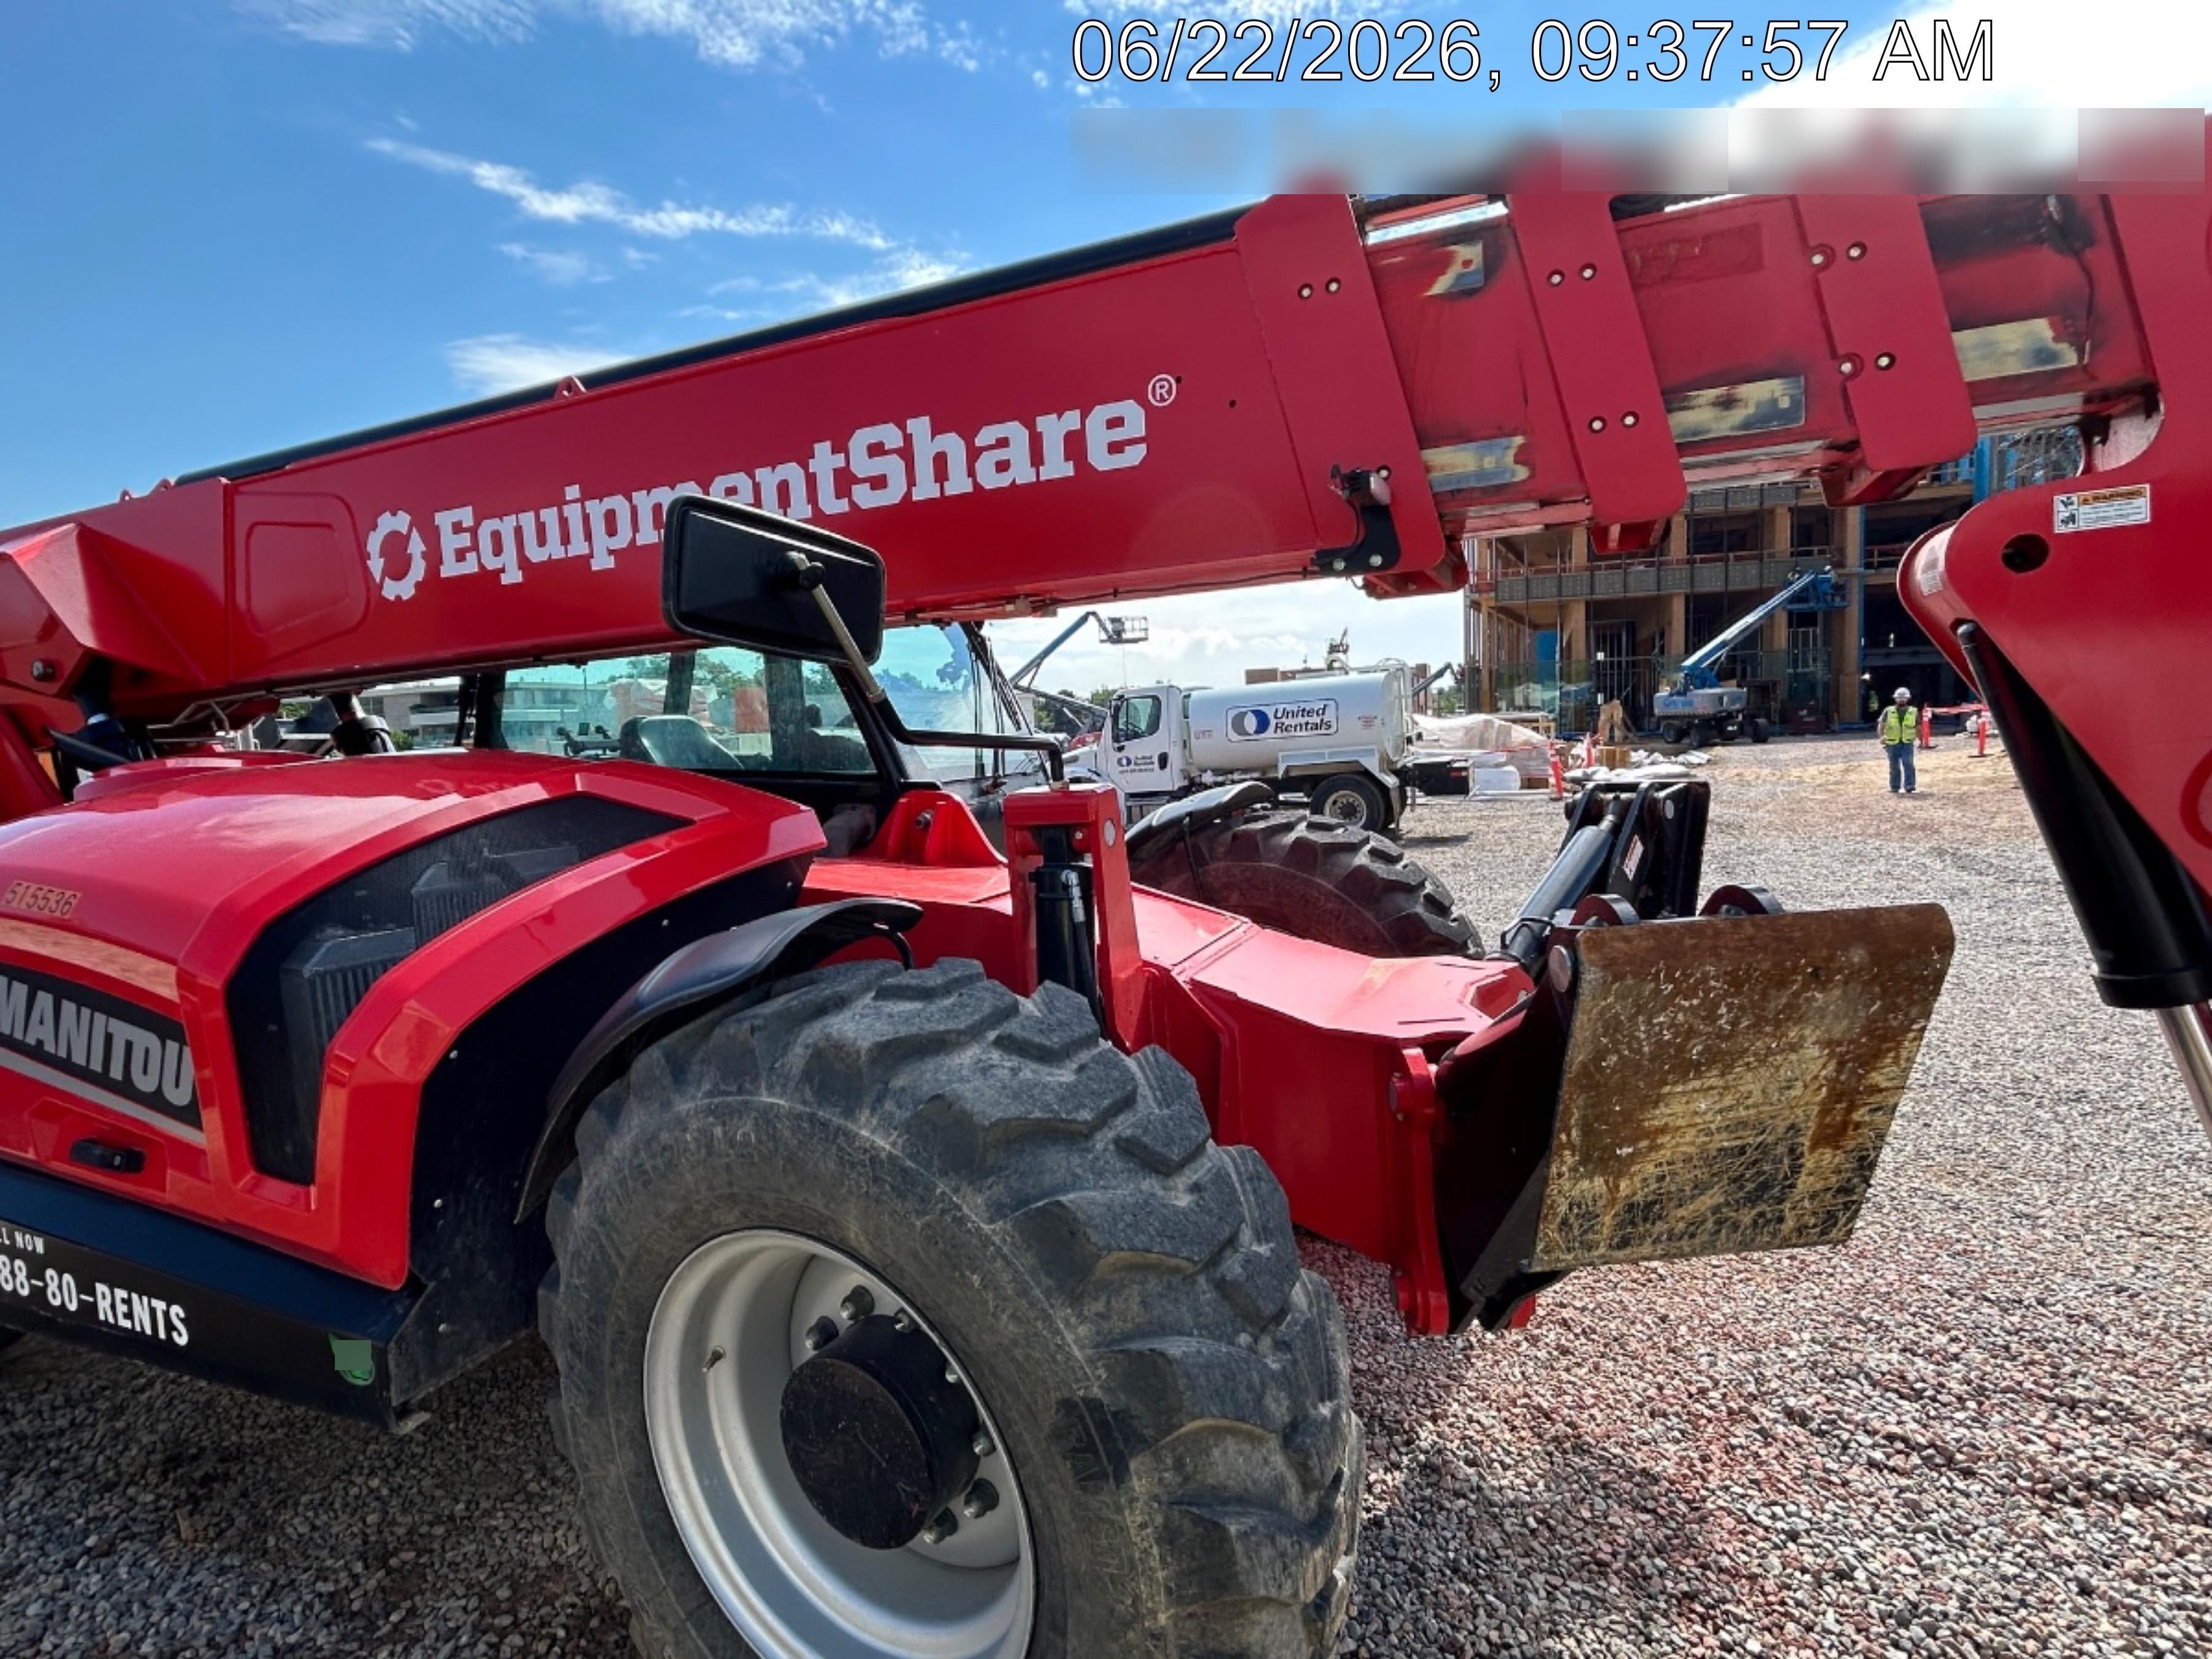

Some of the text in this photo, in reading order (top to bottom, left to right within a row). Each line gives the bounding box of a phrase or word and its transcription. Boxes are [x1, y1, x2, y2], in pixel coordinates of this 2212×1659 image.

[1273, 704, 1327, 720] United
[1273, 716, 1332, 734] Rentals
[5, 882, 77, 916] 515536
[0, 975, 195, 1107] MANITOU
[14, 1230, 45, 1255] NOW
